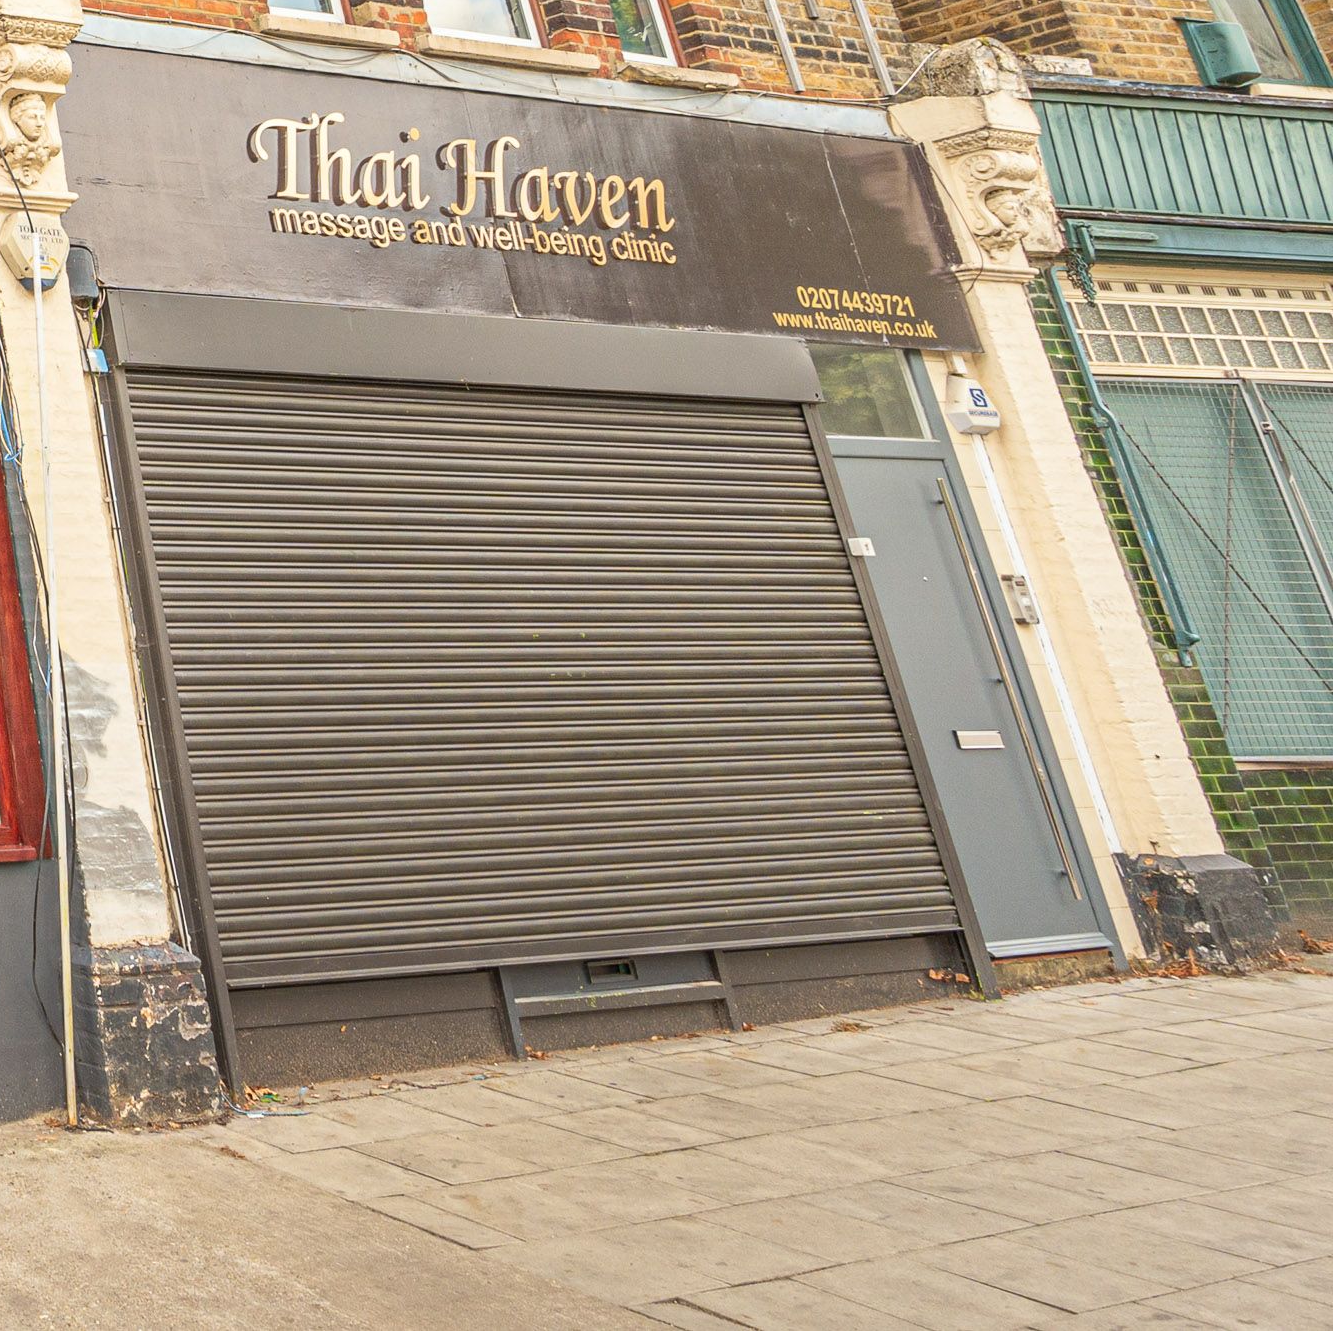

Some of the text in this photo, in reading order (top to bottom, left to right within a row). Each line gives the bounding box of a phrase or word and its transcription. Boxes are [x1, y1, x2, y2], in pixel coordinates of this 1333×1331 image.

[255, 112, 676, 233] Thai Haven
[19, 225, 61, 236] TOLGATE
[274, 207, 677, 266] massage and well-being clinic
[796, 285, 916, 318] 02074439721
[772, 311, 938, 339] www.thaihaven.co.uk
